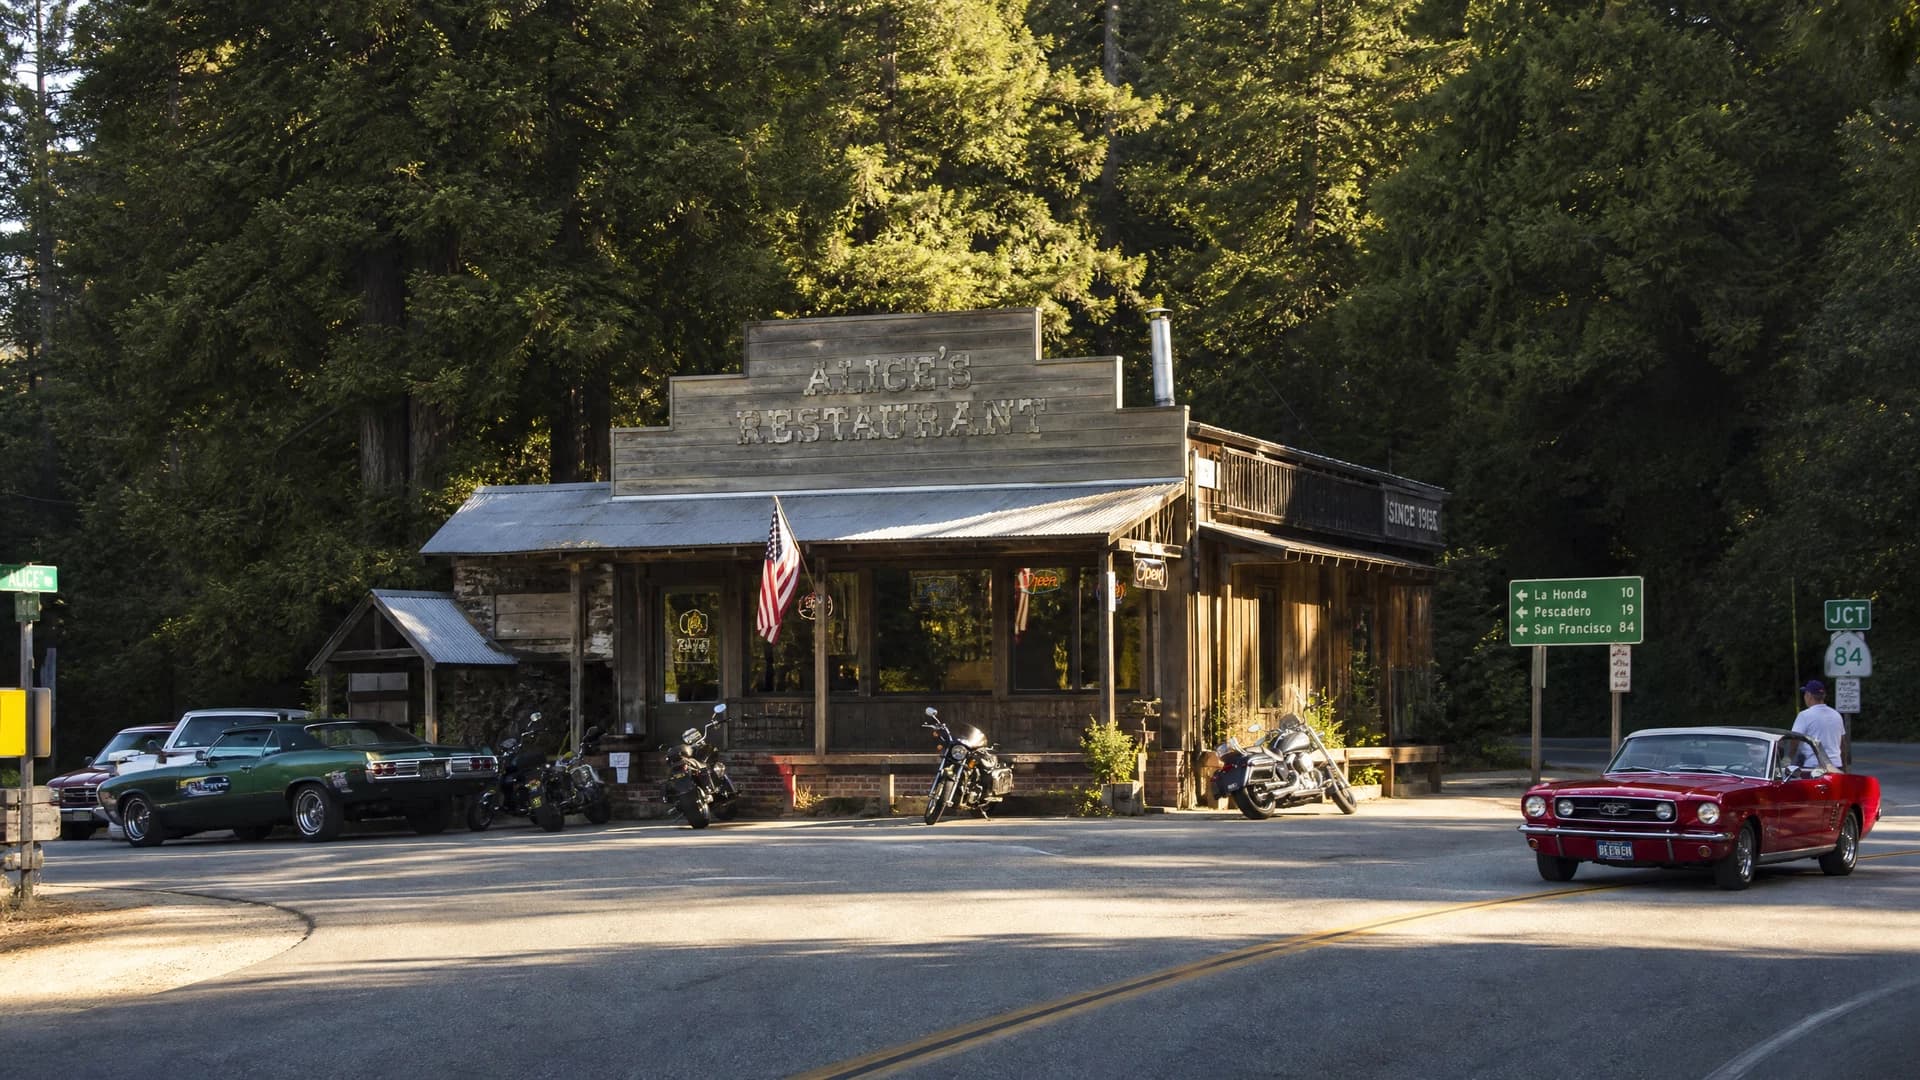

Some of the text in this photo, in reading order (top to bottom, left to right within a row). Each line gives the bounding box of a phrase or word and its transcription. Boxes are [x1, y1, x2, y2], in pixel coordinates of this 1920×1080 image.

[803, 346, 973, 396] ALICE'S
[736, 398, 1046, 445] RESTAURANT
[1388, 501, 1415, 527] SINCE
[1534, 587, 1634, 600] La Honda 10
[1534, 604, 1634, 618] Pescadero 19
[1830, 606, 1866, 624] JCT
[1534, 621, 1634, 635] San Francisco 84
[1834, 646, 1863, 667] 84
